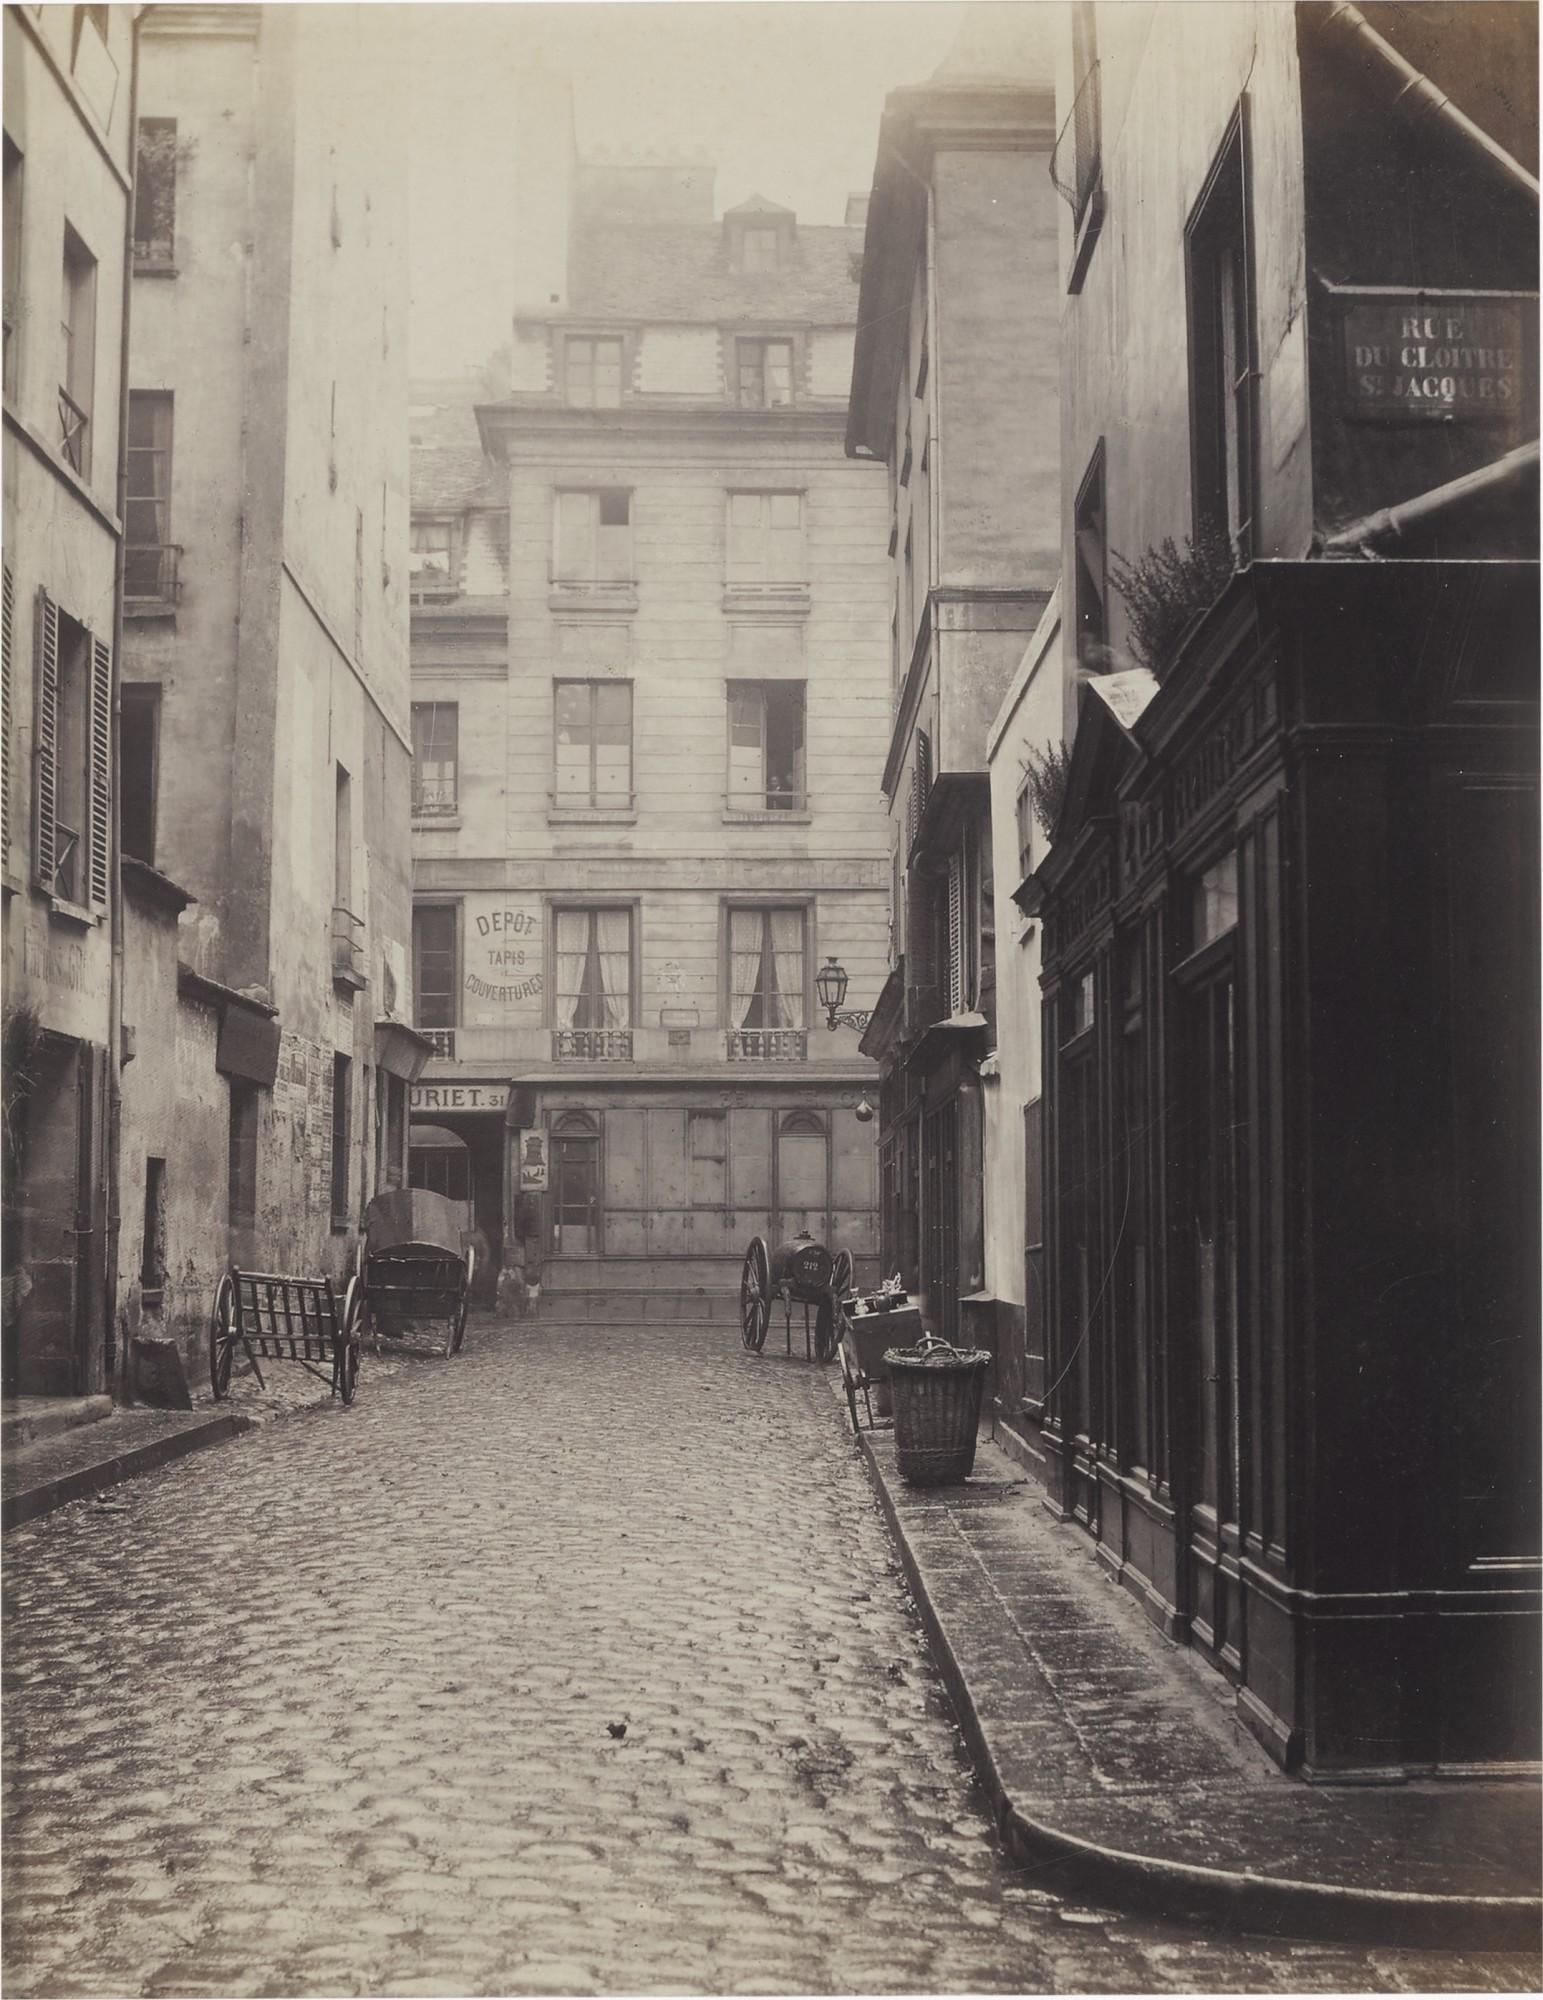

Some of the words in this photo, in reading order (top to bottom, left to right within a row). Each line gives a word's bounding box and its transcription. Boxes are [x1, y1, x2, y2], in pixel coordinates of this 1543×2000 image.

[1401, 317, 1464, 340] RUE
[1355, 344, 1391, 368] DU
[1393, 376, 1513, 402] JACQUES
[488, 950, 526, 966] TAPIS
[464, 973, 544, 1002] COUVERTURES
[489, 1095, 504, 1107] 31
